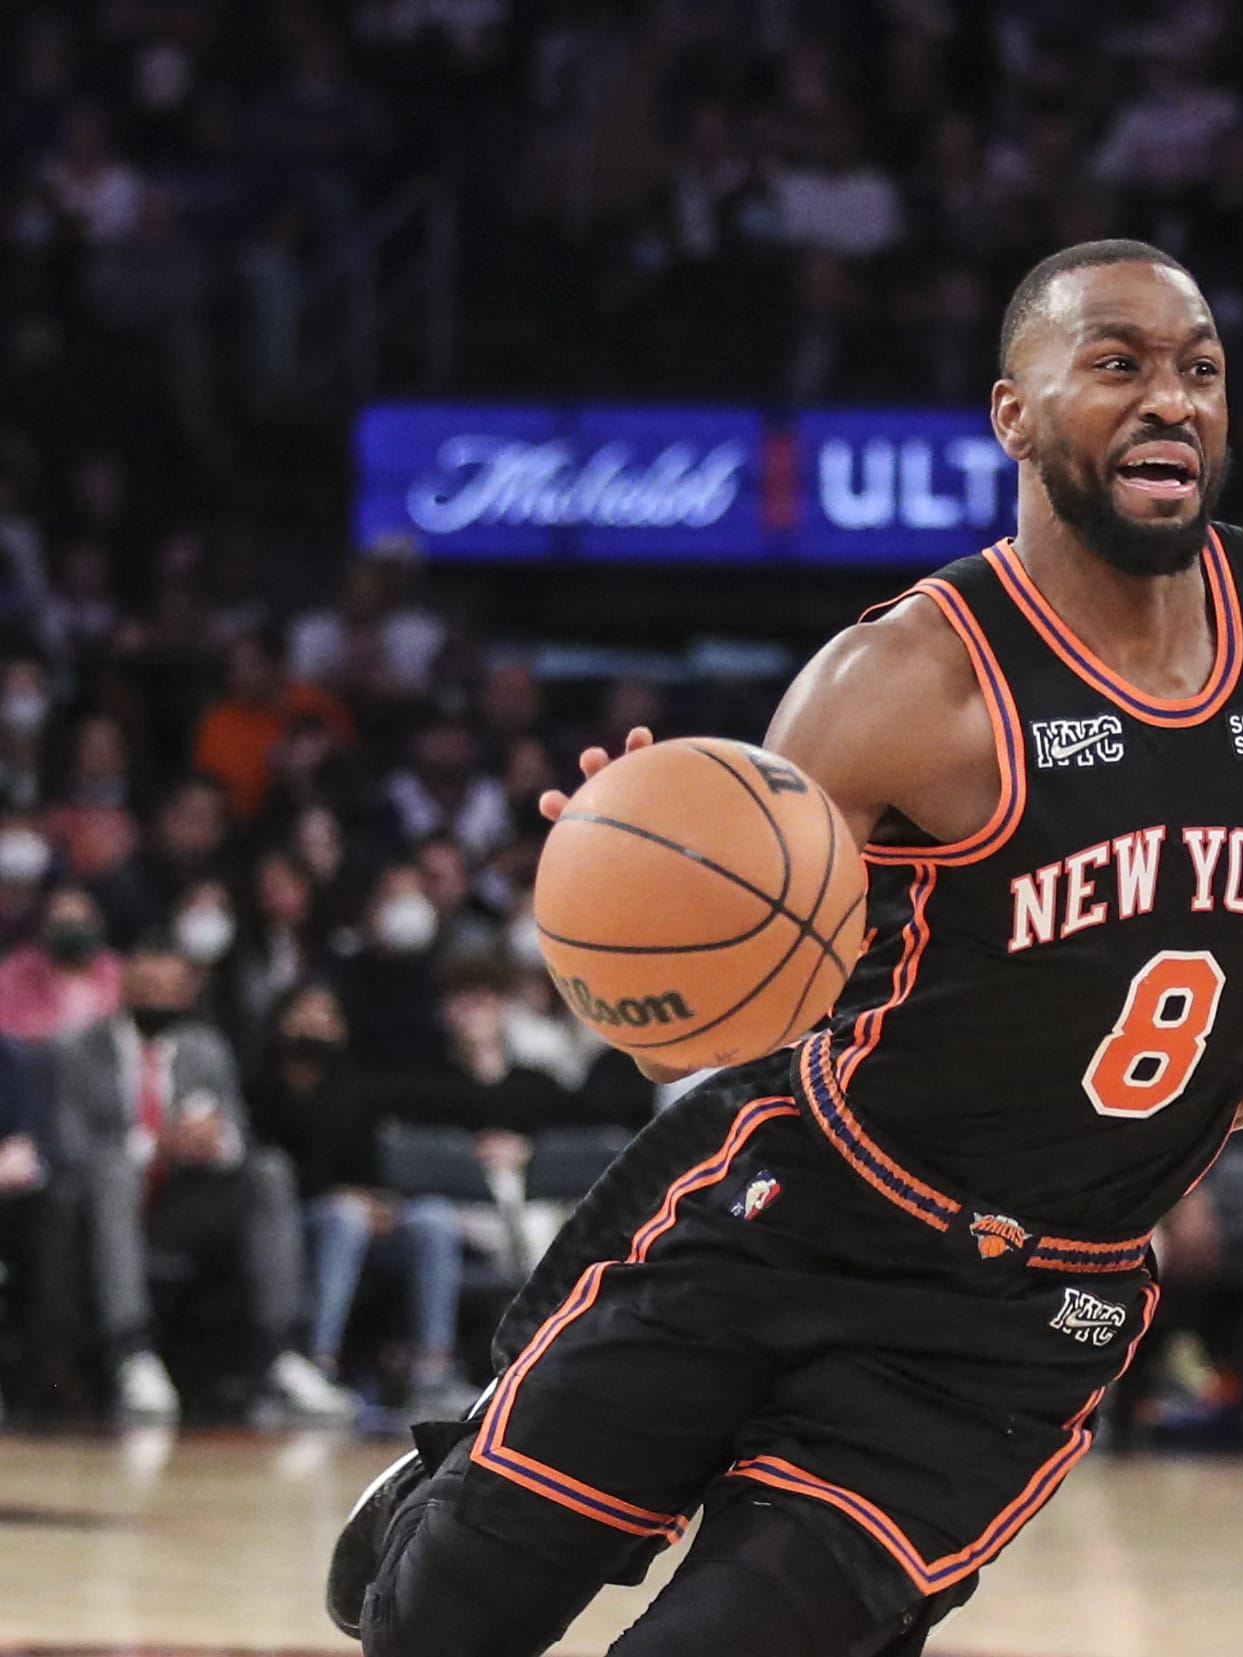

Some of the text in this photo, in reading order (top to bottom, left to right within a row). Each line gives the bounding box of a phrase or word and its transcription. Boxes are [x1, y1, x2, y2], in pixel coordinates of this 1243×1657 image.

[818, 436, 1018, 531] ULT
[1032, 714, 1125, 768] NYC
[1008, 825, 1167, 953] NEW
[1081, 950, 1226, 1119] 8
[1049, 1287, 1126, 1346] NYC
